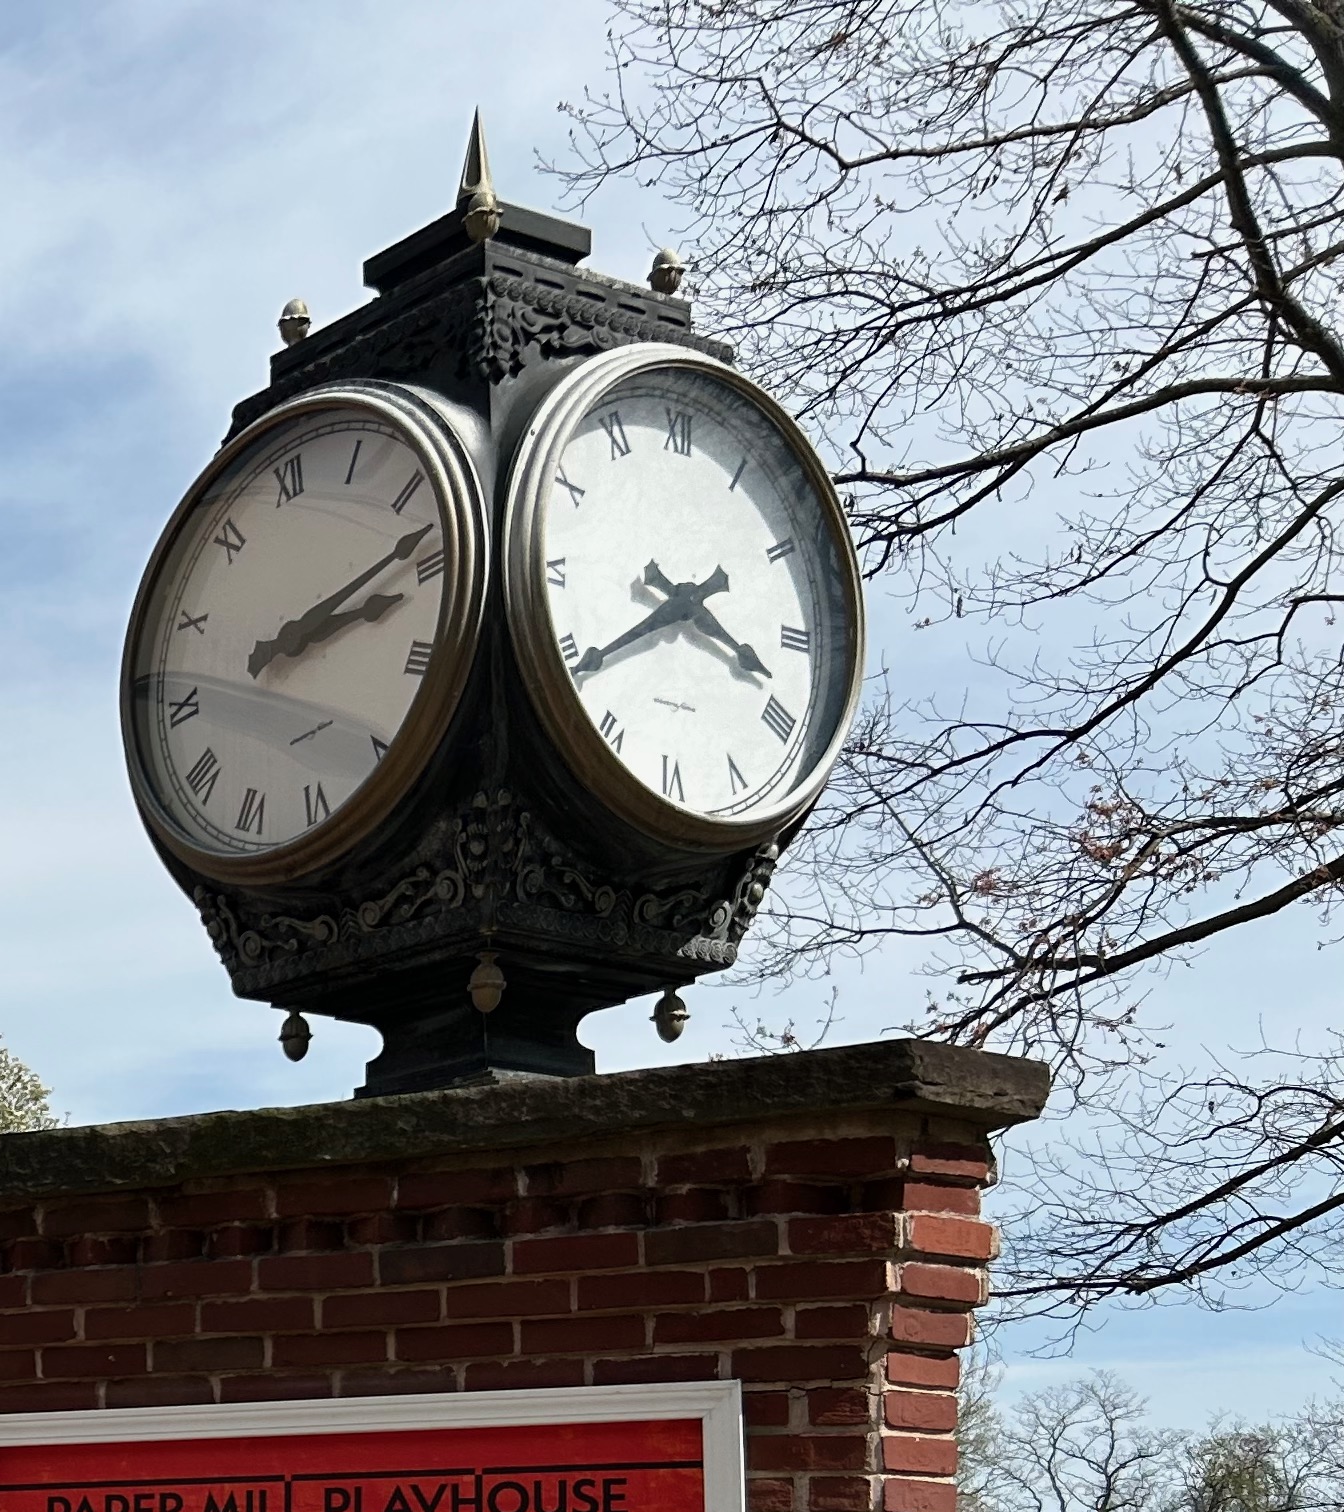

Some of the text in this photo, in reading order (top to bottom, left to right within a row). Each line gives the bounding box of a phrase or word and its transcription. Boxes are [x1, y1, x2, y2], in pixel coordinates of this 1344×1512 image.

[598, 411, 632, 461] XI
[663, 407, 692, 458] XII
[273, 453, 304, 508] XII
[391, 469, 425, 515] II
[554, 465, 586, 508] X
[213, 517, 248, 565] XI
[765, 538, 796, 563] II
[177, 610, 209, 635] X
[781, 624, 811, 655] III
[169, 687, 199, 729] IX
[185, 747, 221, 806] VIII
[661, 755, 686, 804] VI
[235, 788, 266, 835] VII
